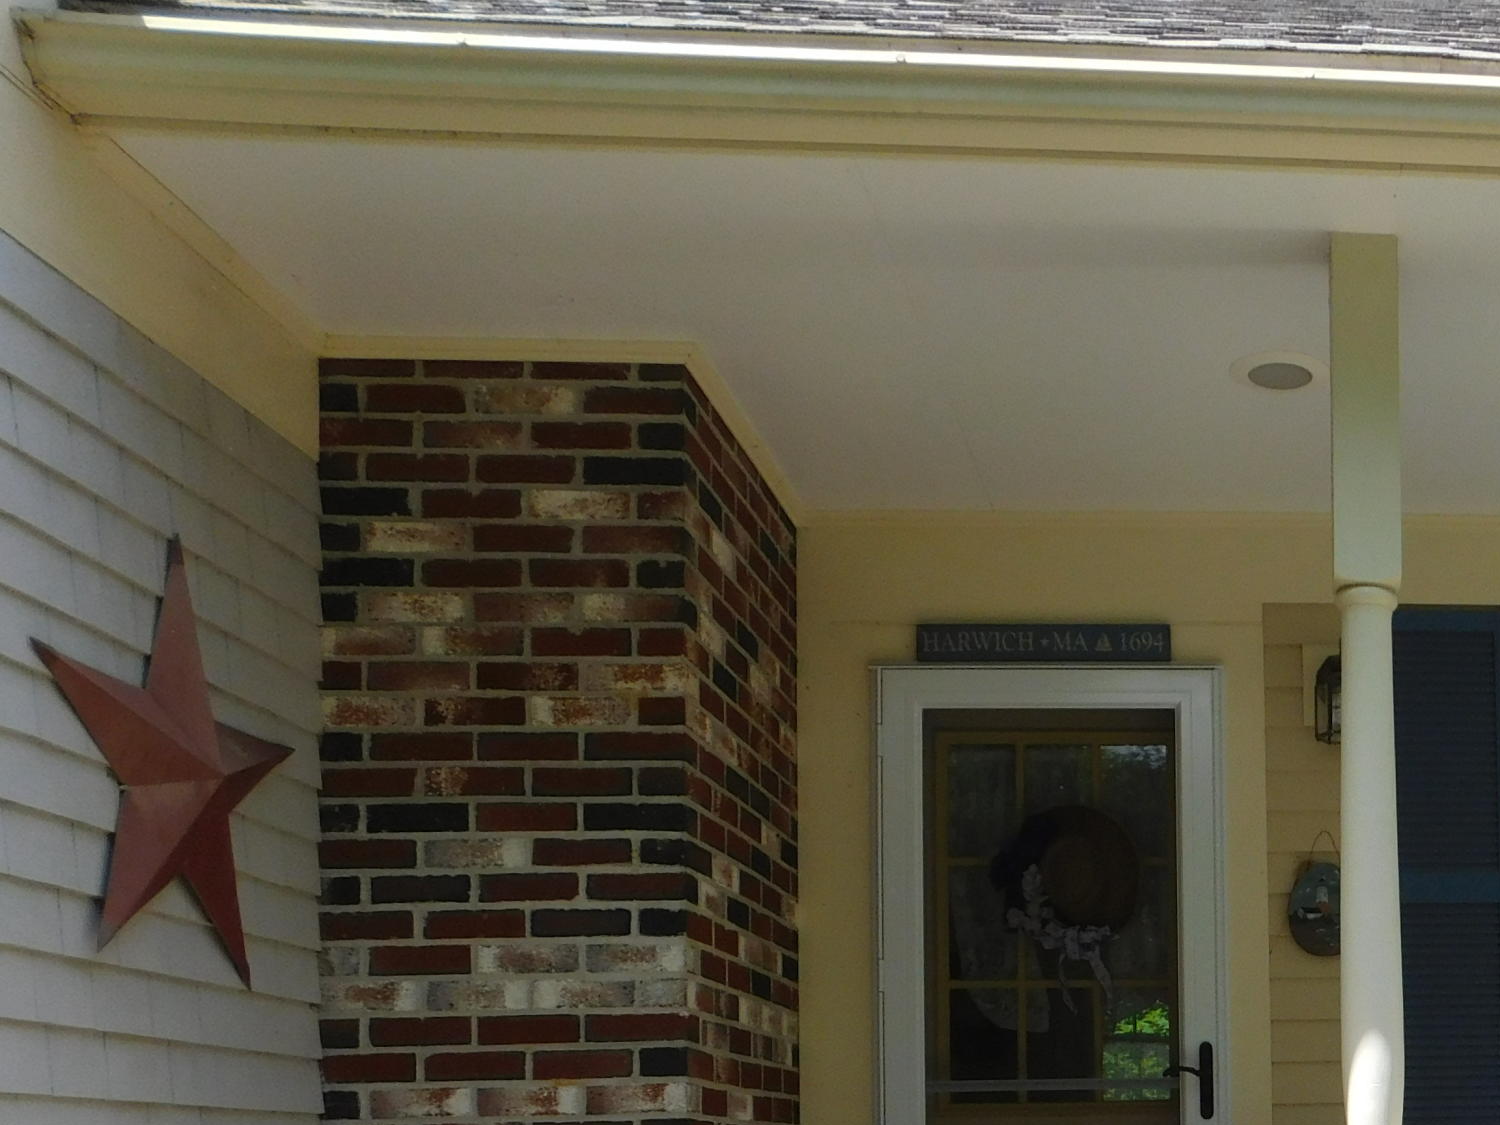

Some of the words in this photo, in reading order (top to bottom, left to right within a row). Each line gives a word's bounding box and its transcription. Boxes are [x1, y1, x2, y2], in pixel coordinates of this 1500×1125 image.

[921, 631, 1034, 652] HARWICH
[1053, 631, 1089, 652] MA
[1120, 631, 1165, 653] 1694
